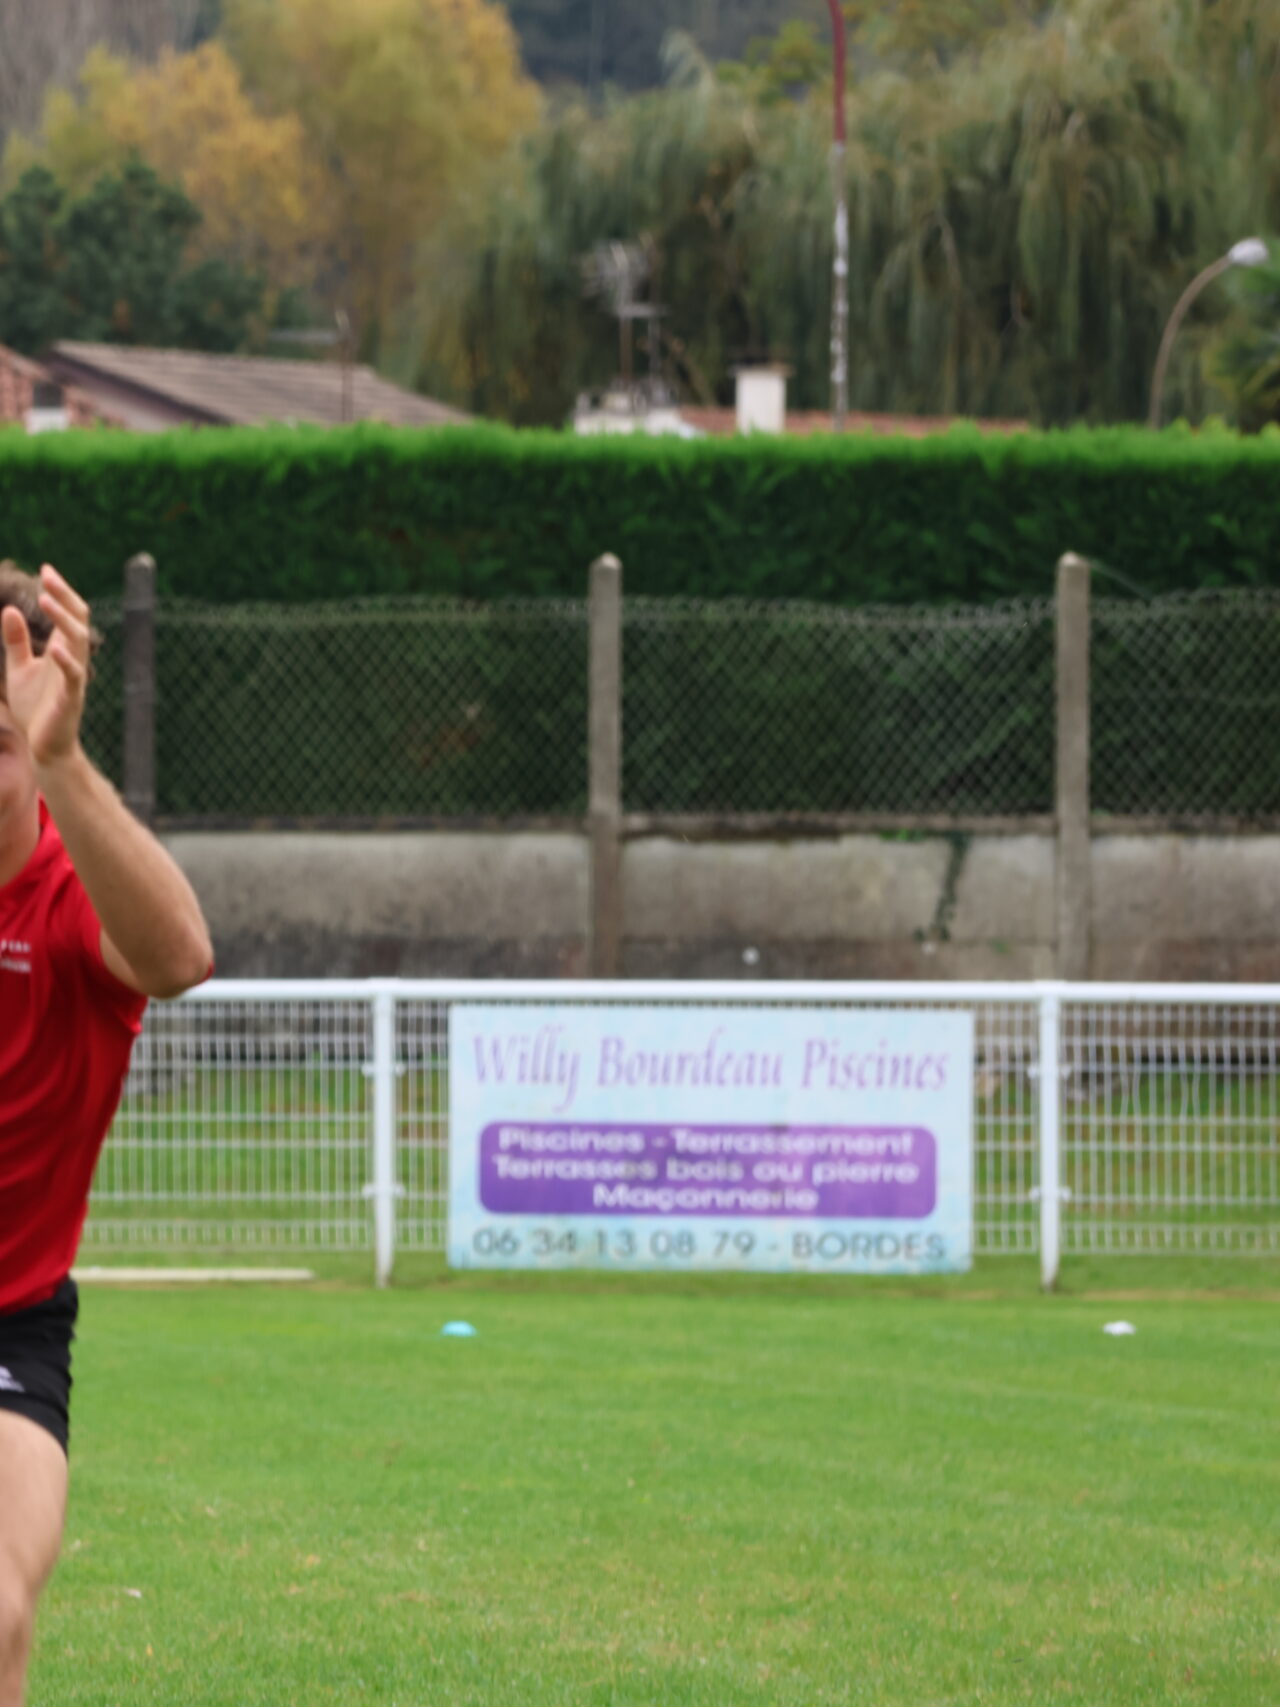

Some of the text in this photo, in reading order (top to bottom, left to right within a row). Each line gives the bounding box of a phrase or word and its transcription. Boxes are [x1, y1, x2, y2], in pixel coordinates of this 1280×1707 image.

[473, 1025, 949, 1113] Willy Bourdeau Piscines
[498, 1128, 644, 1152] Piscines
[671, 1129, 913, 1155] Terrassement
[492, 1154, 918, 1185] Terrasses bois ou pierre
[592, 1182, 818, 1211] Maçonnerie
[473, 1228, 519, 1256] 06
[532, 1228, 577, 1256] 34
[596, 1228, 636, 1258] 13
[649, 1229, 695, 1258] 08
[712, 1230, 756, 1258] 79
[792, 1230, 945, 1260] BORDES
